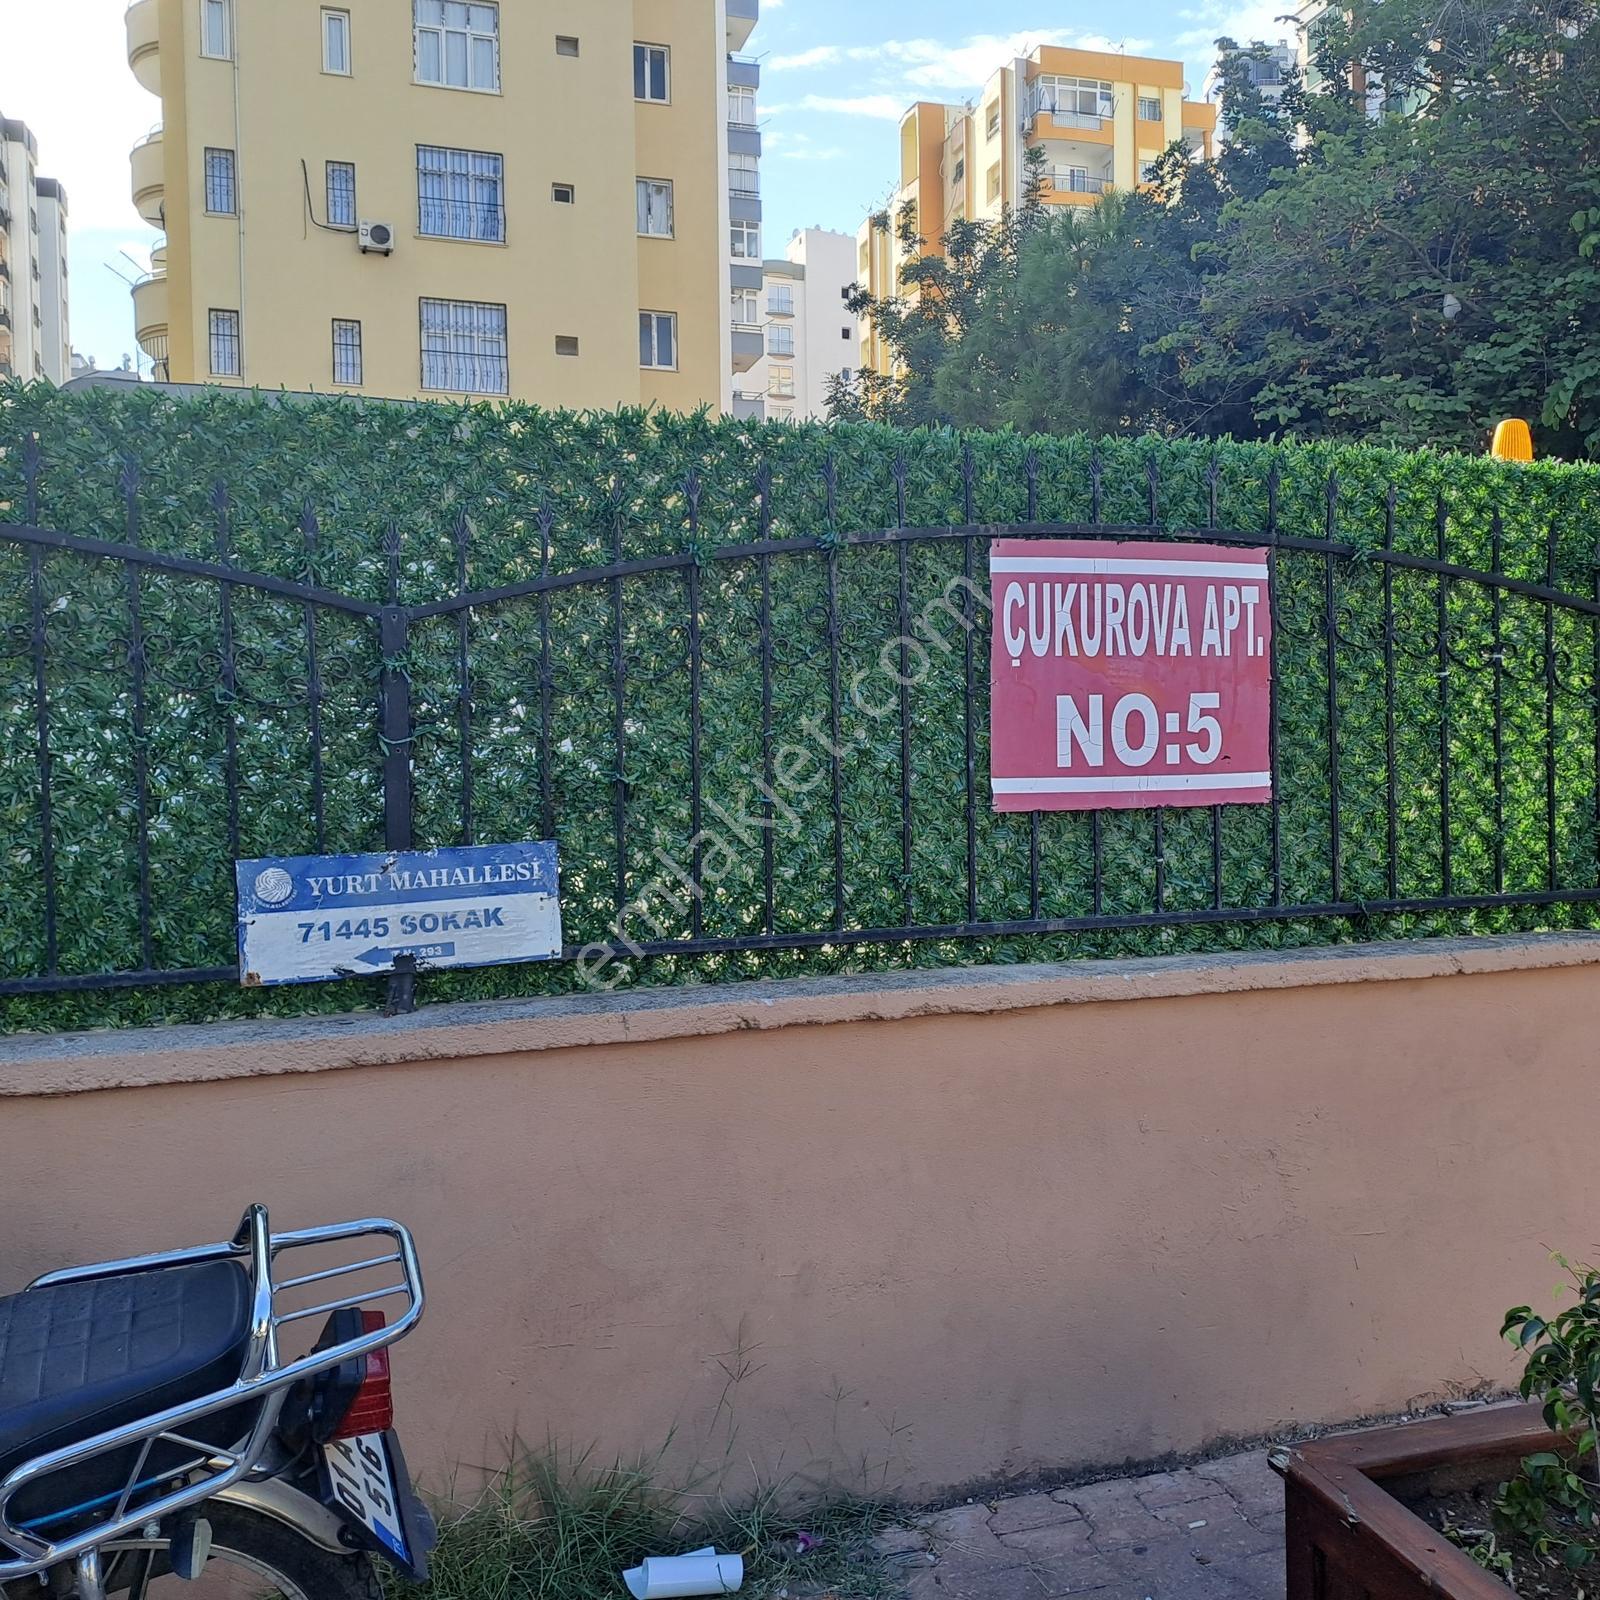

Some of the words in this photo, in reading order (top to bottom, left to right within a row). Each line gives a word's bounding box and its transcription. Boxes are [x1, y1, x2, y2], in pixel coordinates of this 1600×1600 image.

[1003, 581, 1192, 667] ÇUKUROVA
[1200, 584, 1264, 657] APT.
[1056, 692, 1223, 768] NO:5
[305, 873, 382, 897] YURT
[389, 856, 543, 892] MAHALLESİ
[298, 917, 389, 943] 71445
[400, 906, 504, 935] SOKAK
[355, 1436, 392, 1517] 516
